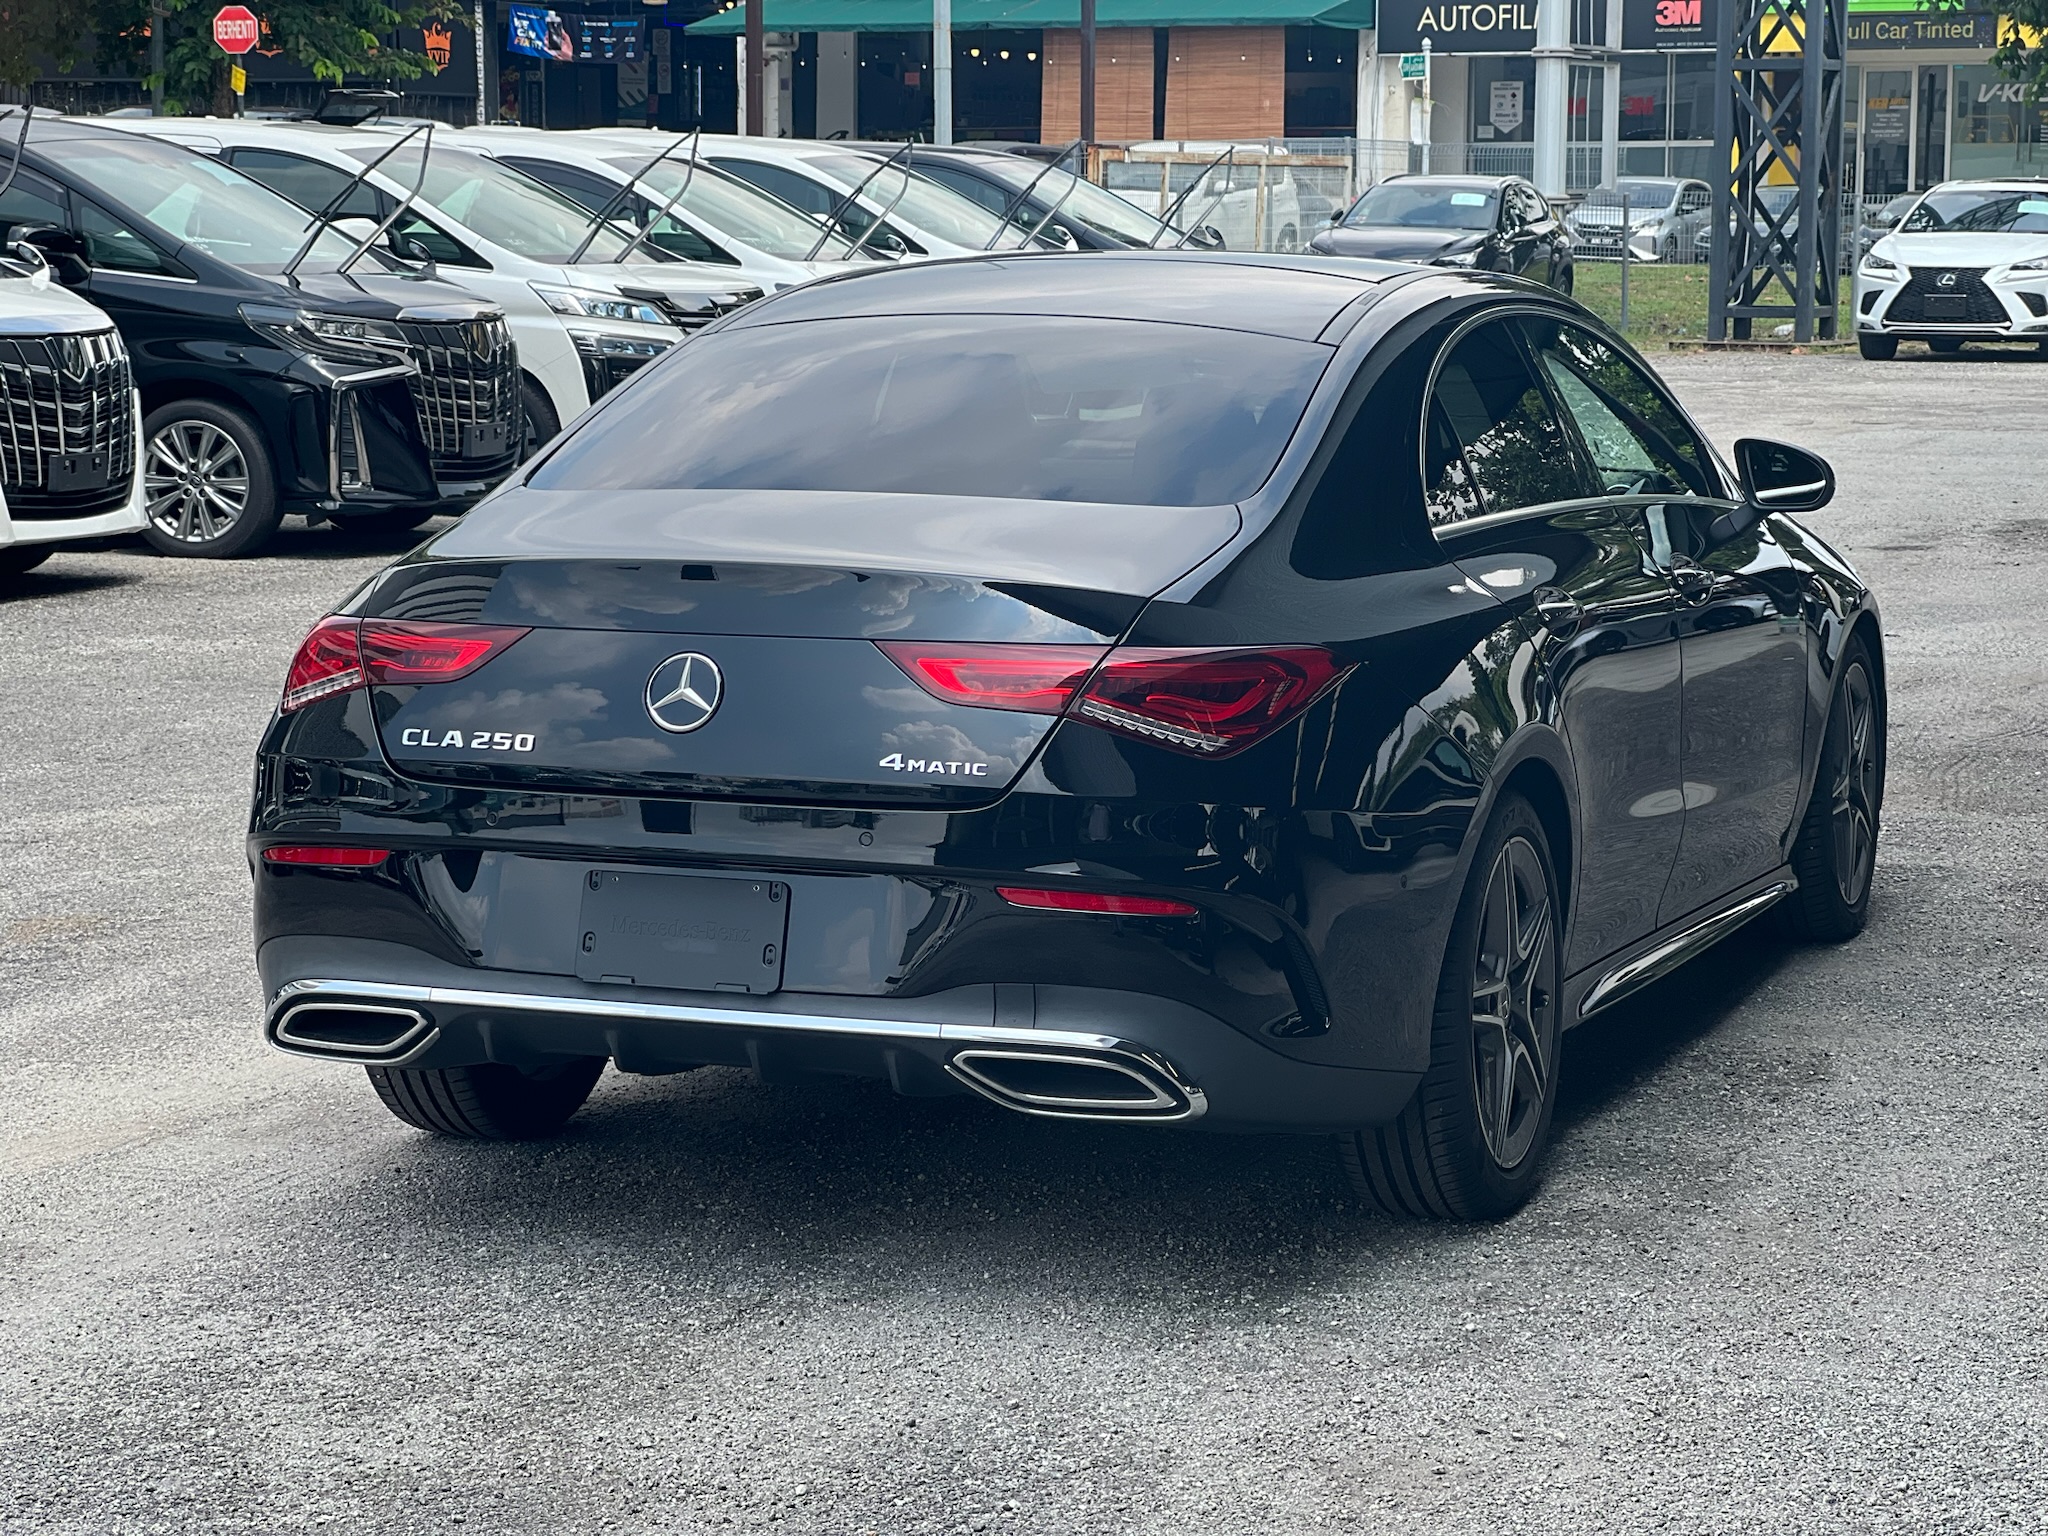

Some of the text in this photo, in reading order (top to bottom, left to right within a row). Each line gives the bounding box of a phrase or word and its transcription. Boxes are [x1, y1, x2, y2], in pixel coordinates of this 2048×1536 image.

[1417, 4, 1538, 31] AUTOFIL
[1655, 0, 1701, 25] 3M
[217, 20, 254, 40] BERHENTI
[513, 17, 530, 30] WE
[1847, 20, 1974, 40] ull Car Tinted
[514, 36, 530, 48] FIX
[517, 28, 536, 40] CAN
[1978, 83, 2048, 102] V-K
[1624, 96, 1655, 116] 3M
[401, 728, 536, 752] CLA 250
[879, 753, 988, 776] 4MATIC
[610, 914, 752, 943] Mercedes-Benz
